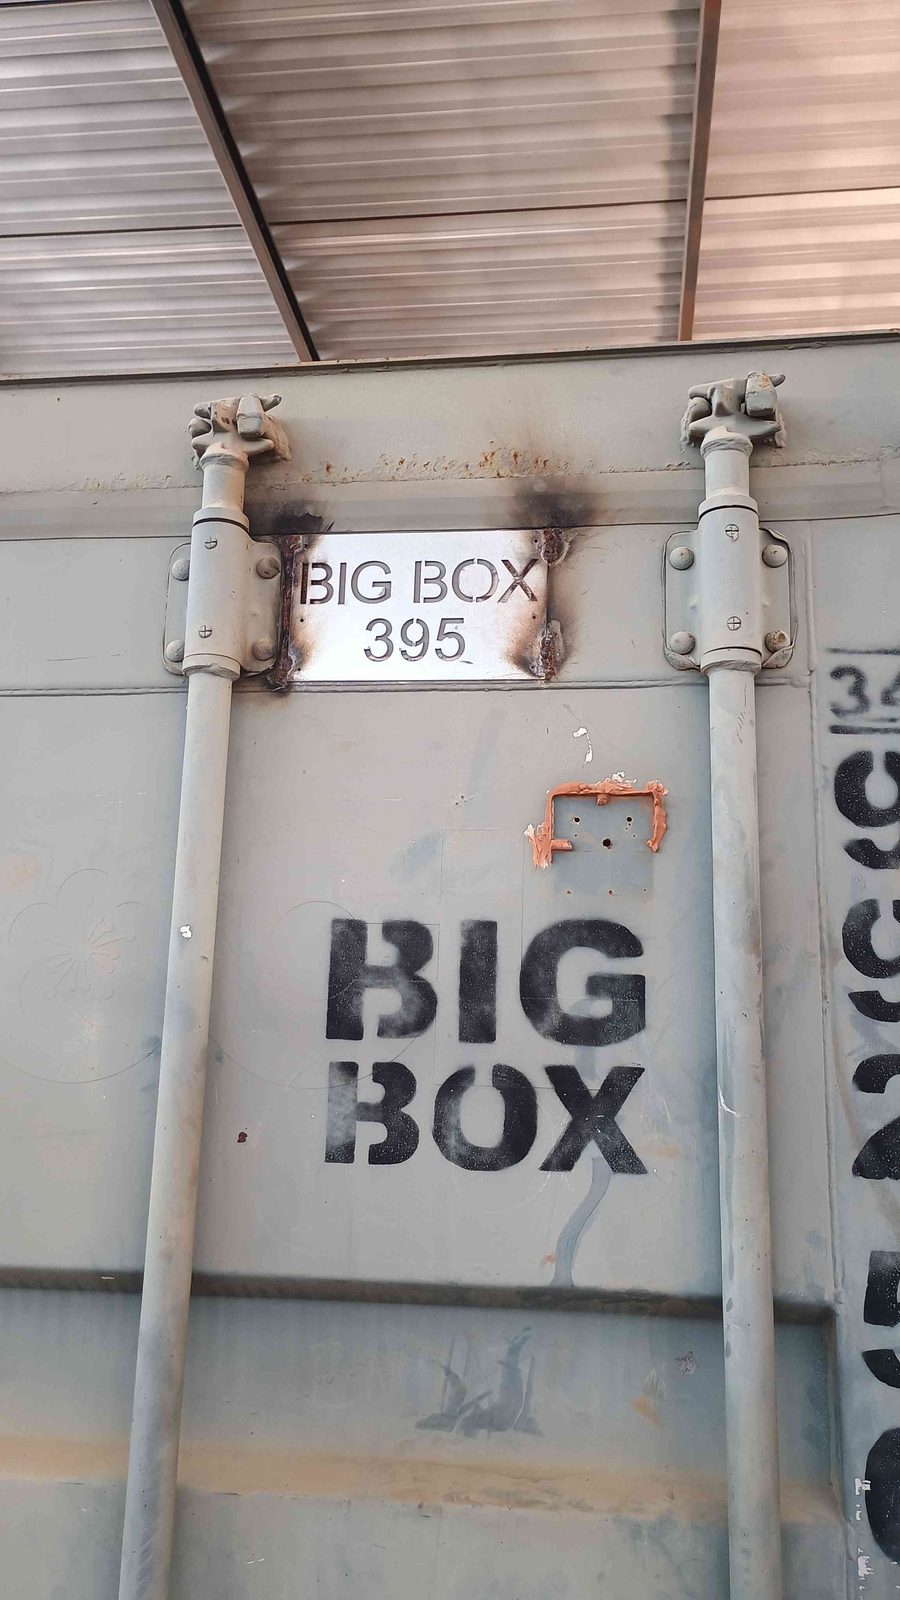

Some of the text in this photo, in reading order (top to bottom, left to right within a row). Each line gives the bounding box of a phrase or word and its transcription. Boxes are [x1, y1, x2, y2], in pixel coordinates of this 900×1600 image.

[299, 557, 539, 605] BIG BOX
[363, 617, 466, 663] 395
[325, 917, 646, 1047] BIG
[324, 1060, 648, 1175] BOX
